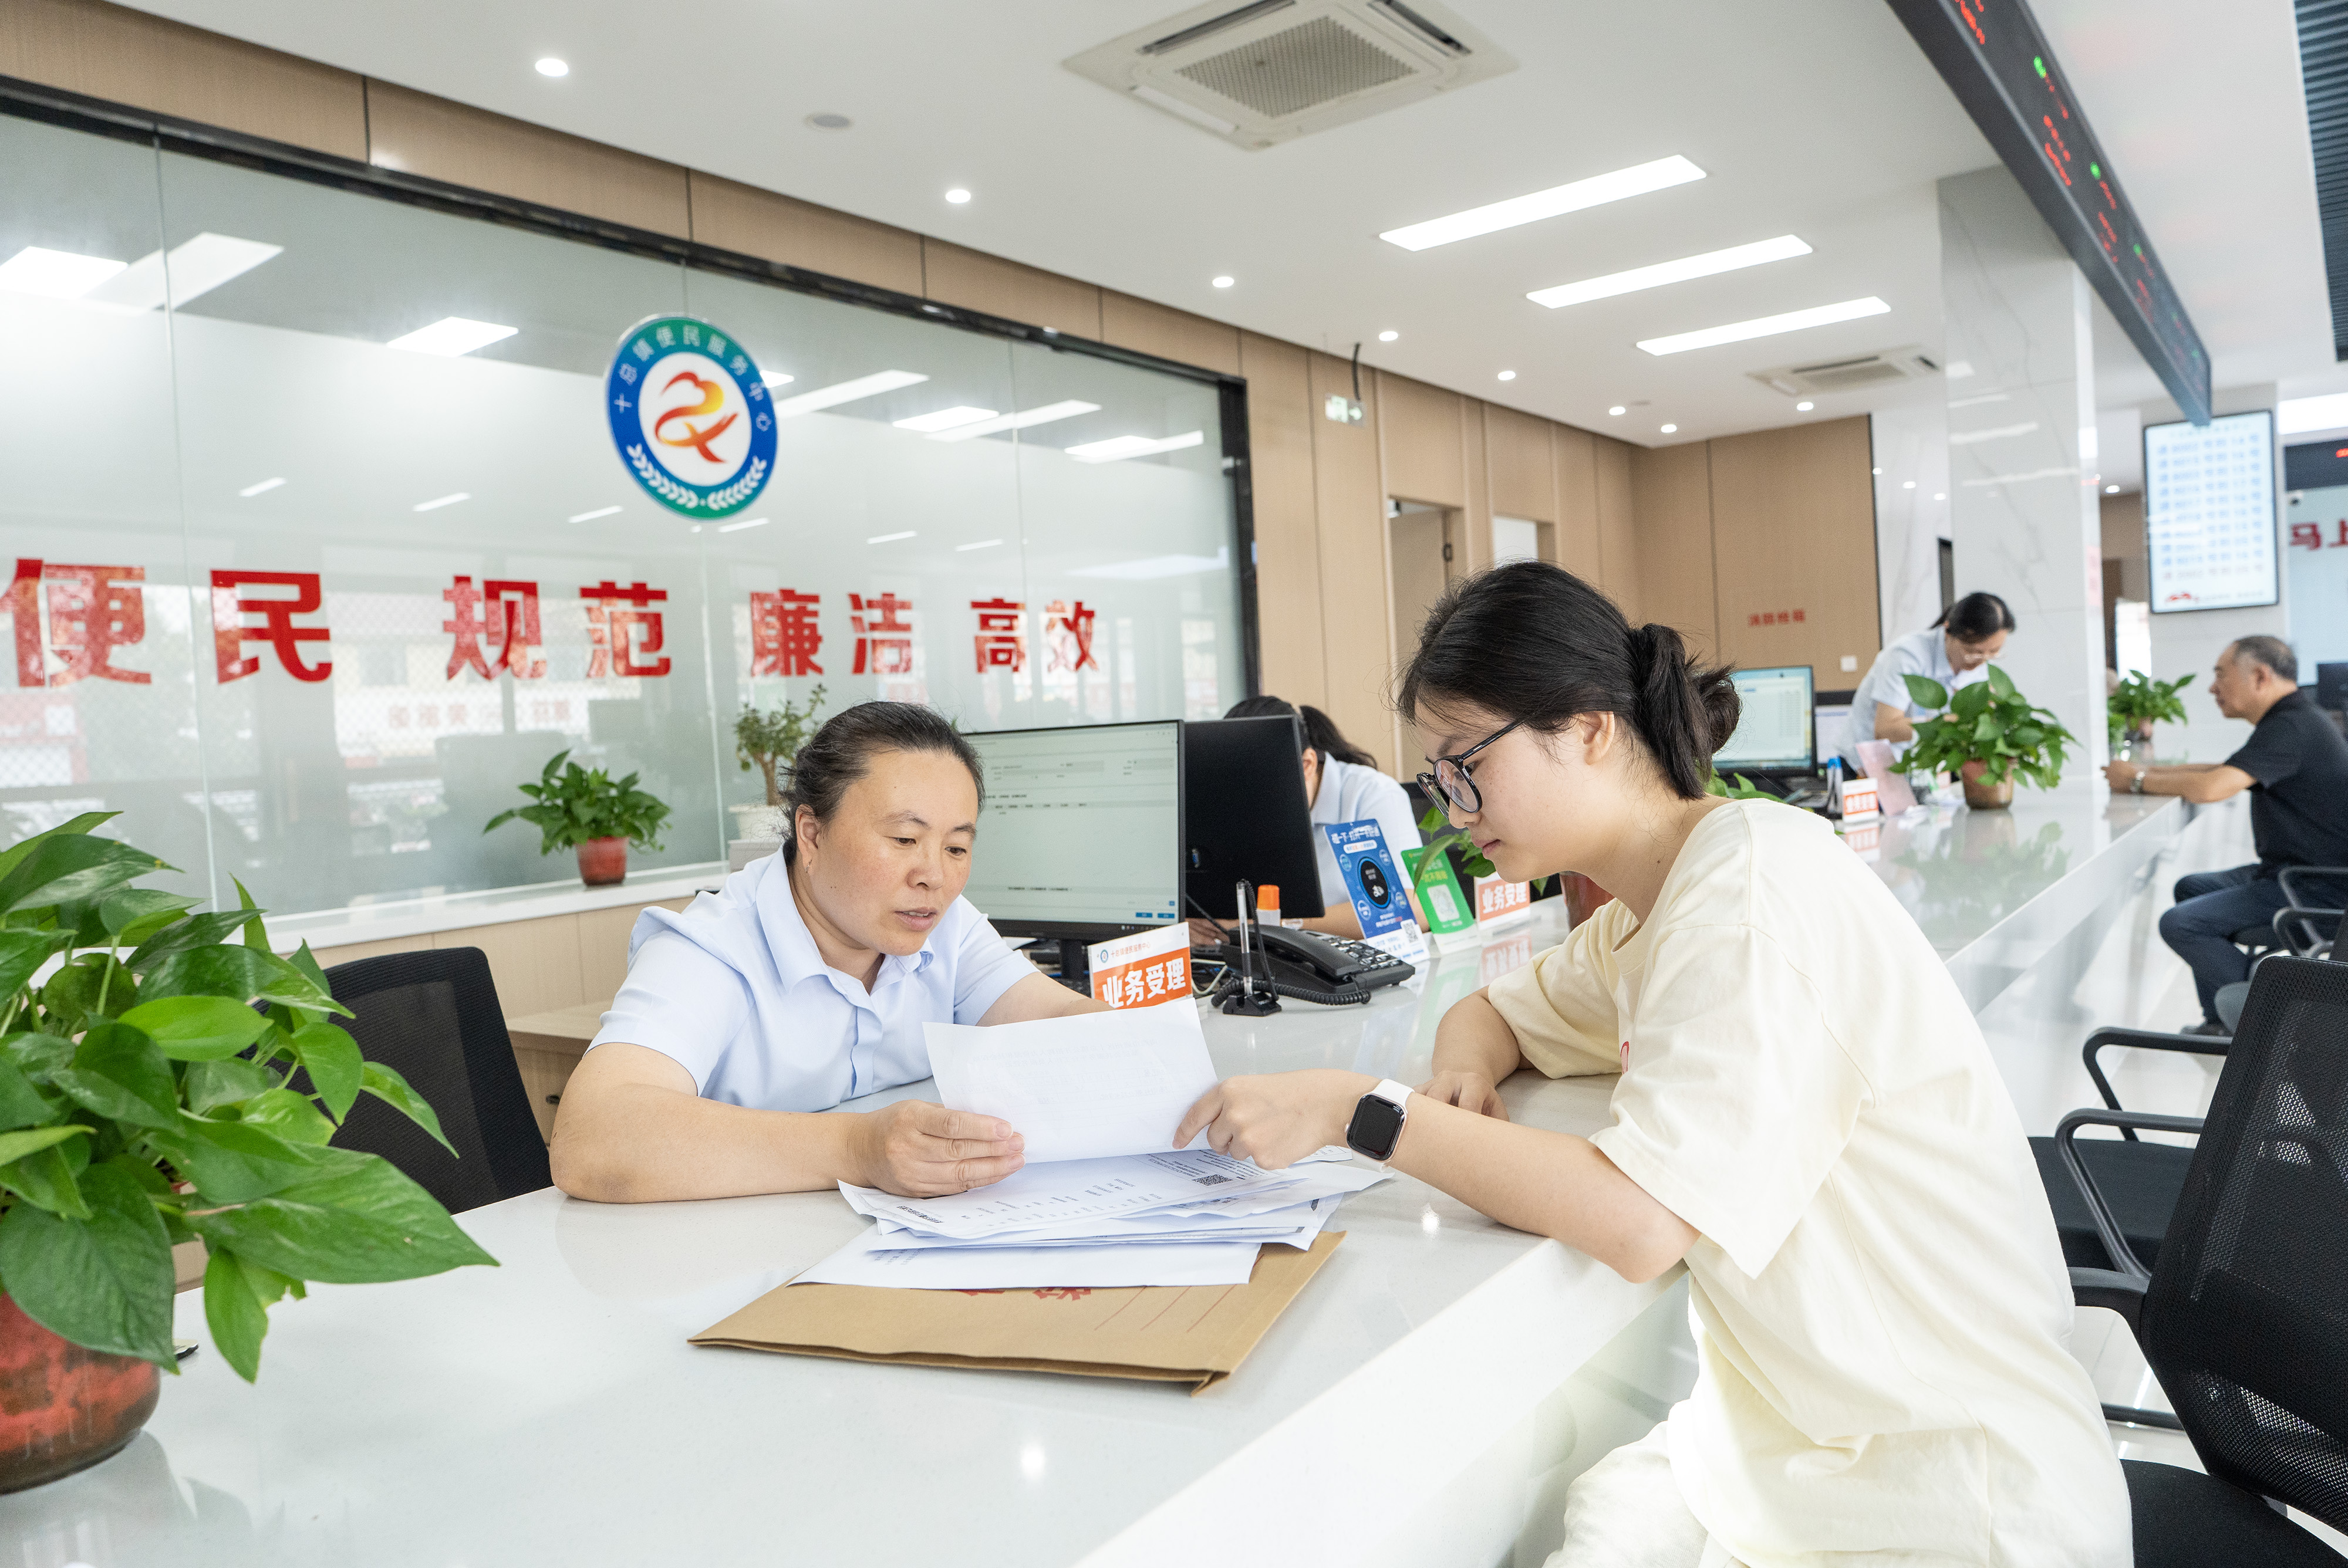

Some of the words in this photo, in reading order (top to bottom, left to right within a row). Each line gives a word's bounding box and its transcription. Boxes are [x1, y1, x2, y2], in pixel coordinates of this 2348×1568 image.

[0, 558, 332, 687] 便民
[443, 576, 672, 681] 规范
[751, 589, 913, 677] 廉洁
[971, 597, 1098, 674] 高效
[1482, 882, 1527, 914] 业务受理
[1102, 957, 1186, 1008] 业务受理
